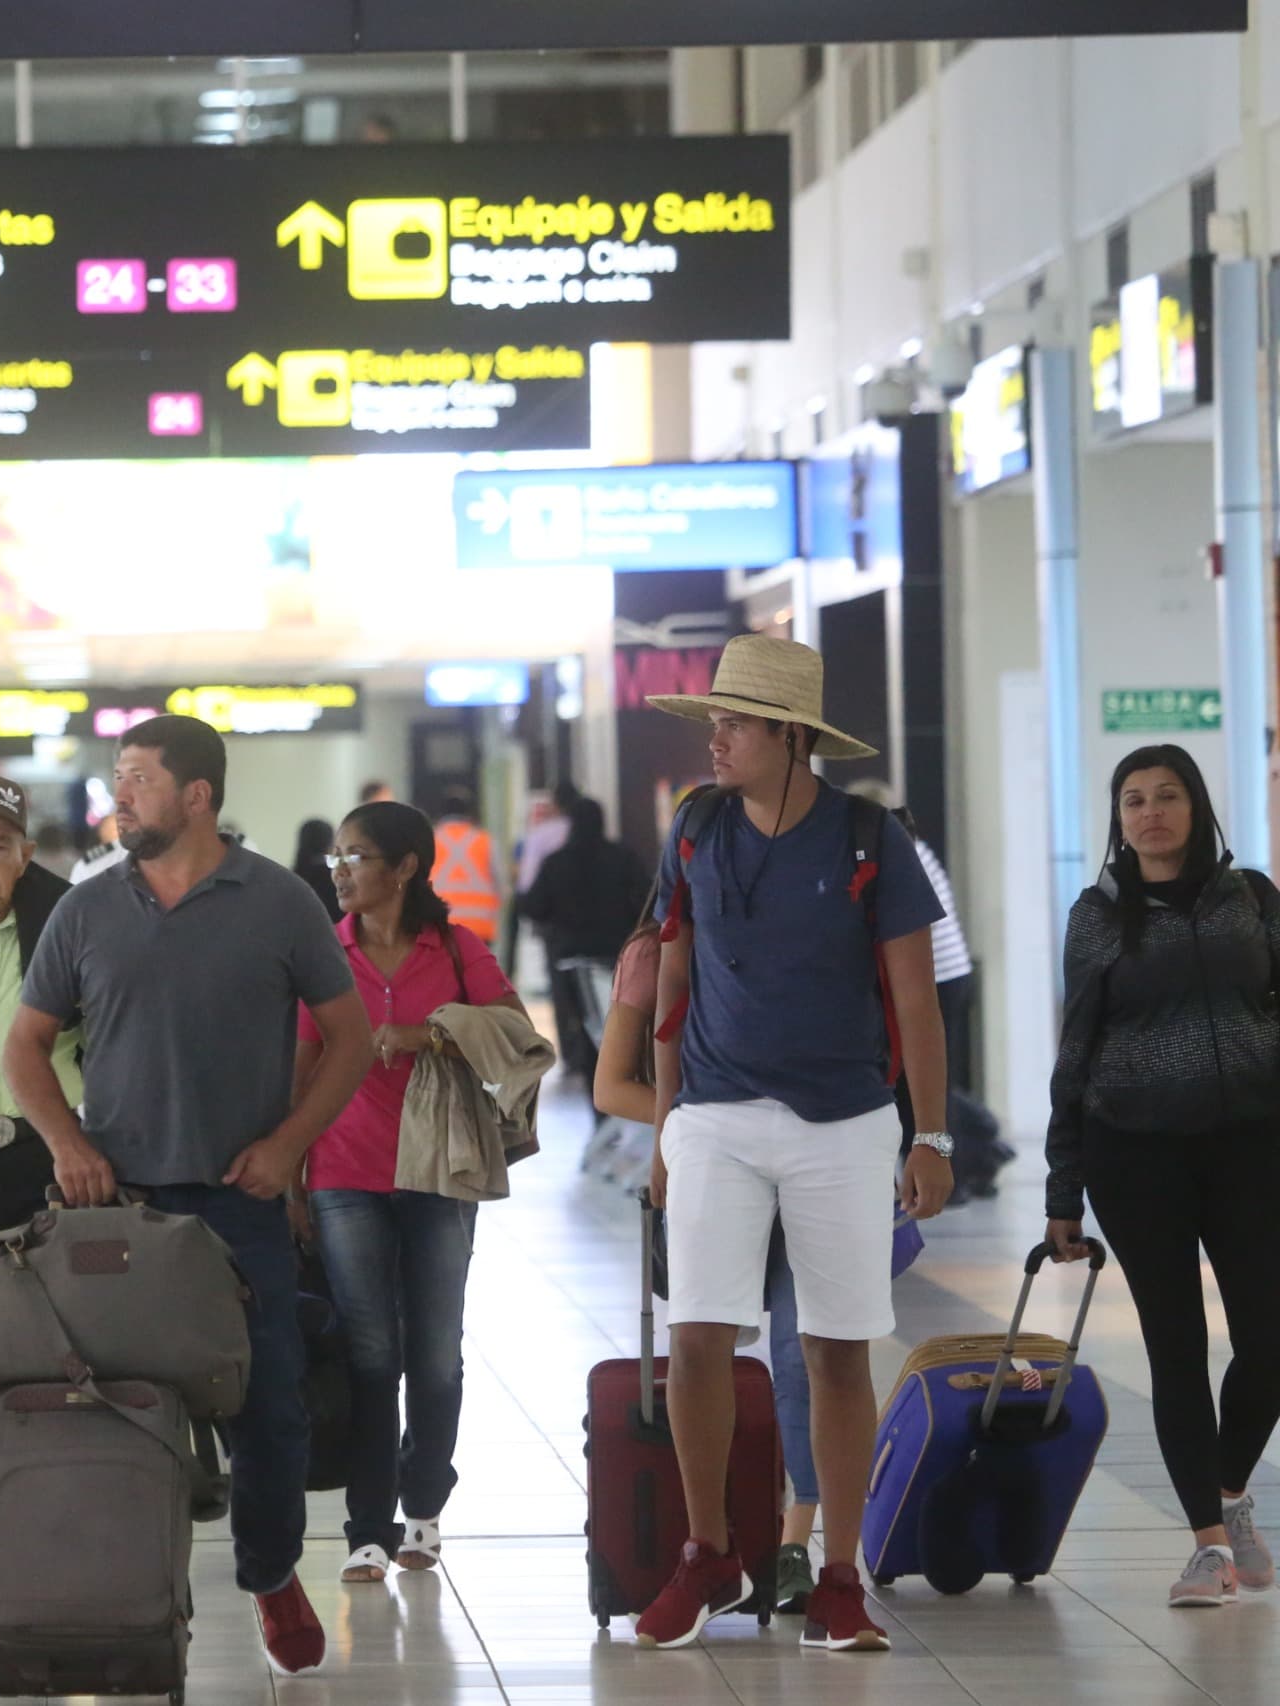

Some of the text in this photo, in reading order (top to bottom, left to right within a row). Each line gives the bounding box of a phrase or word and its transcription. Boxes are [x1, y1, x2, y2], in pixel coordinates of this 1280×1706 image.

[449, 192, 776, 245] Equipaje y Salida
[83, 265, 136, 305] 24
[174, 264, 228, 304] 33
